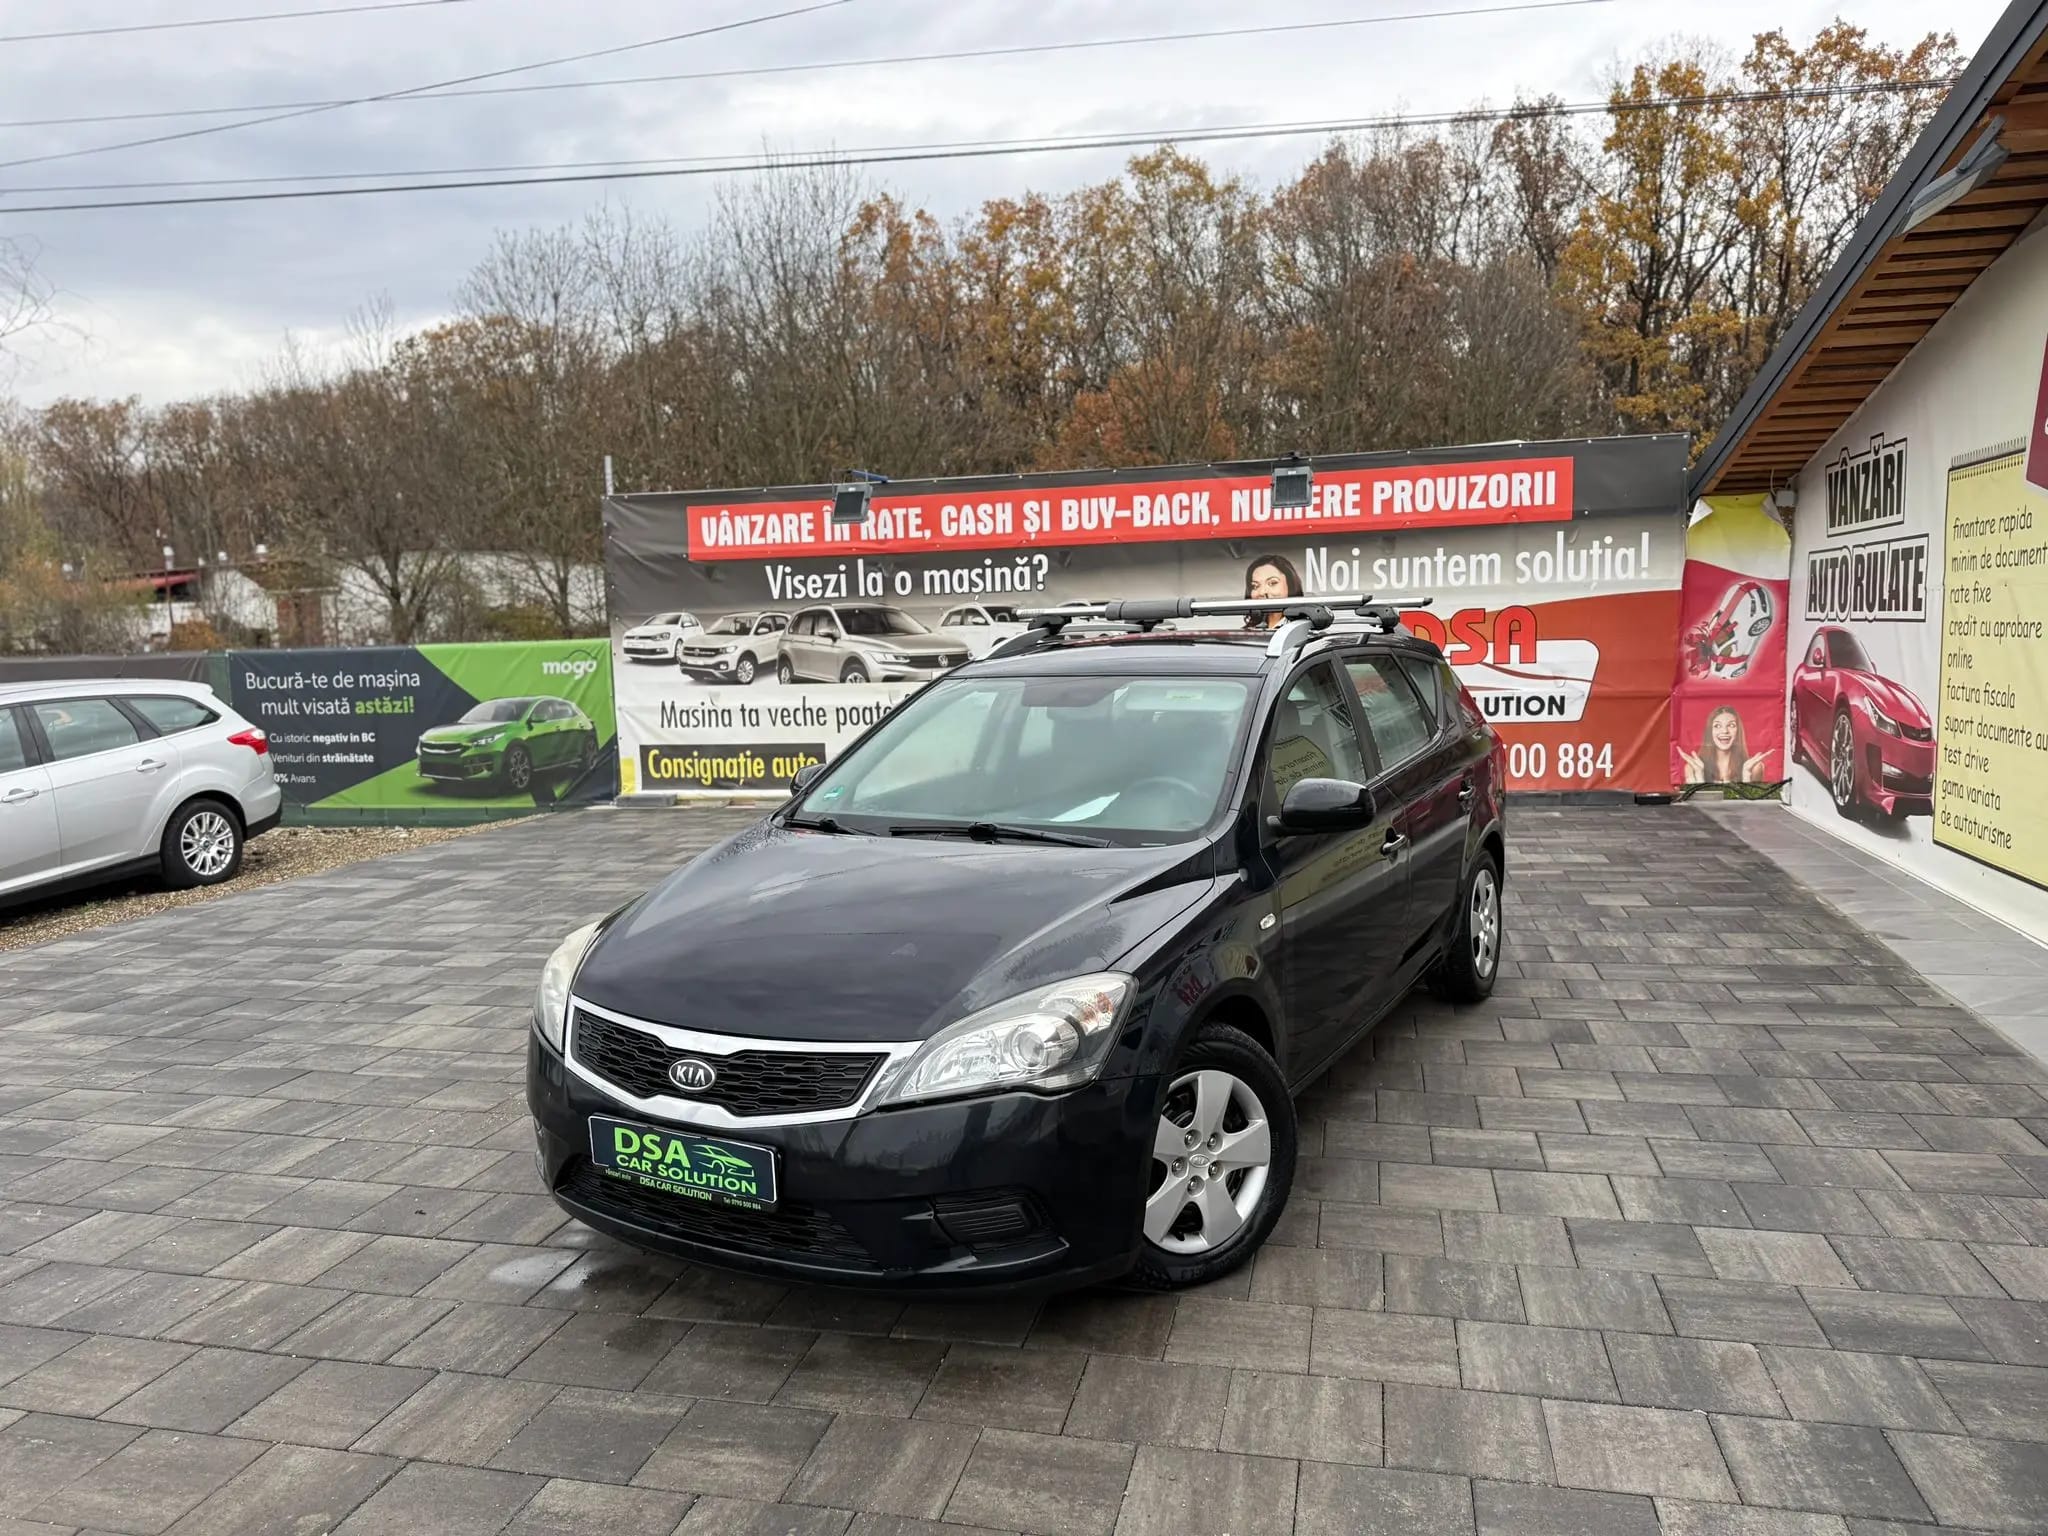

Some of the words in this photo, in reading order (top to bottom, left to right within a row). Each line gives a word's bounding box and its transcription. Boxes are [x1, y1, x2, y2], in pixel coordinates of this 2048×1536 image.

[701, 509, 815, 547] VÂNZARE
[861, 507, 931, 541] RATE,
[941, 502, 1012, 537] CASH
[1061, 491, 1220, 531] BUY-BACK,
[1372, 470, 1556, 515] PROVIZORII
[1953, 517, 1996, 541] finantare
[1999, 505, 2032, 540] rapida
[1305, 546, 1360, 592] Noi
[1372, 547, 1501, 590] suntem
[1951, 550, 1978, 572] minim
[1980, 546, 1992, 569] de
[765, 563, 848, 600] Visezi
[857, 558, 884, 597] la
[894, 570, 912, 596] o
[1950, 585, 1970, 604] rate
[1973, 580, 1992, 603] fixe
[1399, 605, 1537, 665] DSA
[1949, 614, 1978, 637] credit
[1980, 619, 1991, 637] cu
[1993, 613, 2043, 645] aprobare
[542, 659, 597, 680] mogo
[1947, 647, 1973, 670] online
[245, 672, 328, 689] Bucură-te
[332, 671, 355, 688] de
[1946, 677, 1981, 704] factura
[1983, 682, 2016, 709] fiscala
[261, 698, 299, 716] mult
[302, 696, 351, 715] visată
[355, 695, 415, 714] astăzi!
[660, 701, 732, 728] Masina
[739, 704, 760, 727] ta
[768, 696, 827, 727] veche
[1472, 695, 1565, 716] UTION
[269, 733, 283, 743] Cu
[284, 733, 311, 743] istoric
[312, 733, 349, 745] negativ
[350, 733, 360, 743] in
[361, 732, 376, 743] BC
[1945, 714, 1974, 739] suport
[1976, 715, 2032, 748] documente
[271, 752, 305, 763] Venituri
[306, 753, 320, 763] din
[1502, 742, 1547, 778] 00
[1557, 742, 1613, 778] 884
[1944, 743, 1961, 765] test
[1964, 748, 1990, 773] drive
[289, 774, 316, 783] Avans
[1942, 778, 1964, 800] gama
[1966, 784, 2001, 812] variata
[1941, 804, 1951, 827] de
[1953, 814, 2012, 850] autoturisme
[676, 1065, 706, 1086] KIA
[614, 1127, 691, 1168] DSA
[616, 1154, 653, 1173] CAR
[657, 1163, 757, 1195] SOLUTION
[639, 1176, 656, 1188] DSA
[656, 1181, 671, 1192] CAR
[672, 1184, 712, 1201] SOLUTION
